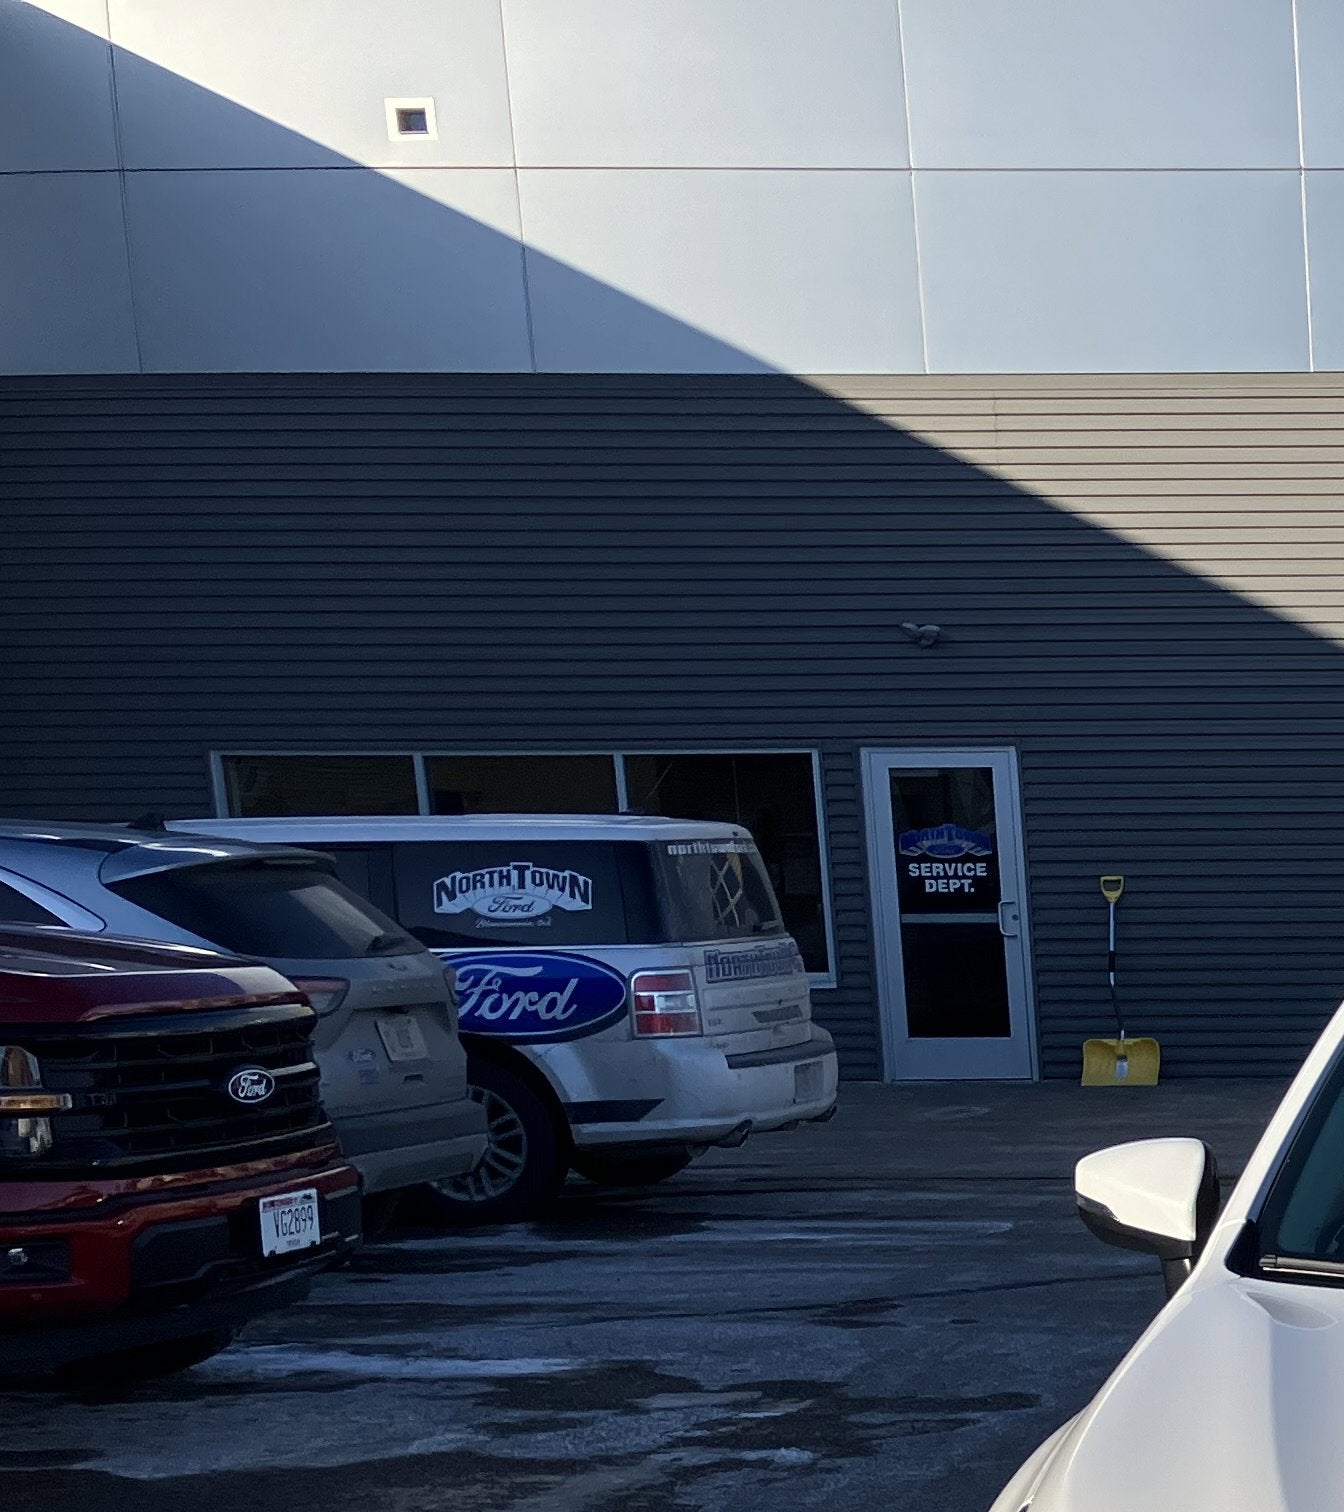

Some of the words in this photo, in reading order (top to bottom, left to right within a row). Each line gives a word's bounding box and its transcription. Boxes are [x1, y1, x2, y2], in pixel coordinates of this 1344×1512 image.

[908, 862, 988, 877] SERVICE
[434, 863, 591, 911] NORTHTOWN
[924, 879, 975, 893] DEPT.
[487, 895, 536, 913] Ford
[455, 963, 580, 1021] Ford
[238, 1074, 267, 1098] Ford
[273, 1204, 314, 1239] VG2899
